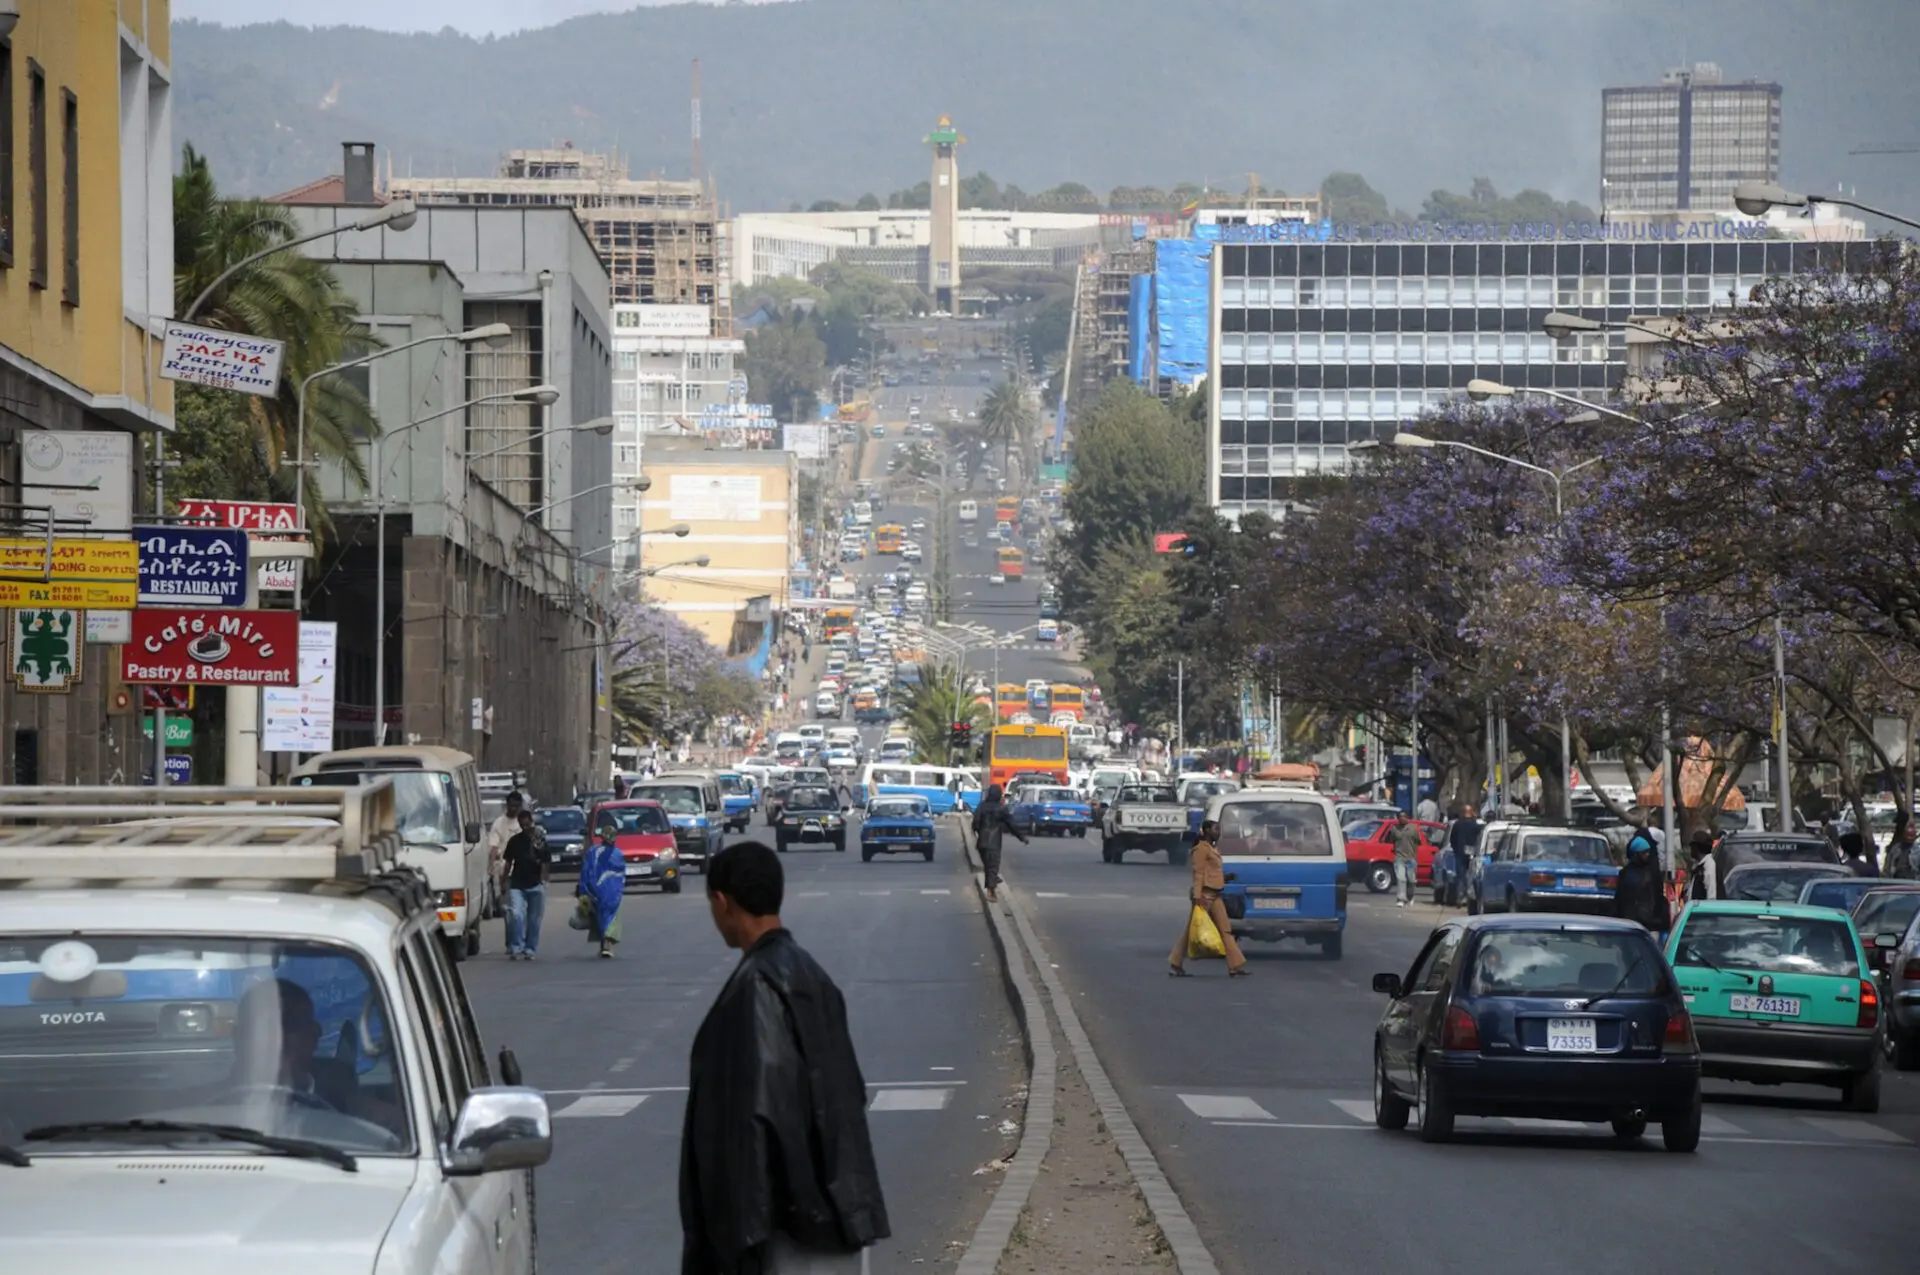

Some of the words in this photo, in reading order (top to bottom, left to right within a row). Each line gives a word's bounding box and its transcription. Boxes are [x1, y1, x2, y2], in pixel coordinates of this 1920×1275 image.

[1508, 222, 1556, 240] AND
[1563, 220, 1768, 240] COMMUNICATIONS
[168, 328, 234, 349] Gallery
[236, 341, 277, 355] Café
[177, 352, 243, 373] Pastry
[165, 360, 273, 386] Restaurant
[29, 589, 50, 601] FAX
[150, 580, 238, 595] RESTAURANT
[145, 614, 205, 653] Café
[219, 615, 274, 658] Miru
[127, 664, 182, 682] Pastry
[185, 665, 197, 680] &
[202, 666, 290, 682] Restaurant
[166, 725, 191, 739] Bar
[1130, 814, 1178, 823] TOYOTA
[1756, 998, 1791, 1013] 76131
[40, 1011, 106, 1025] TOYOTA
[1551, 1035, 1593, 1049] 73335
